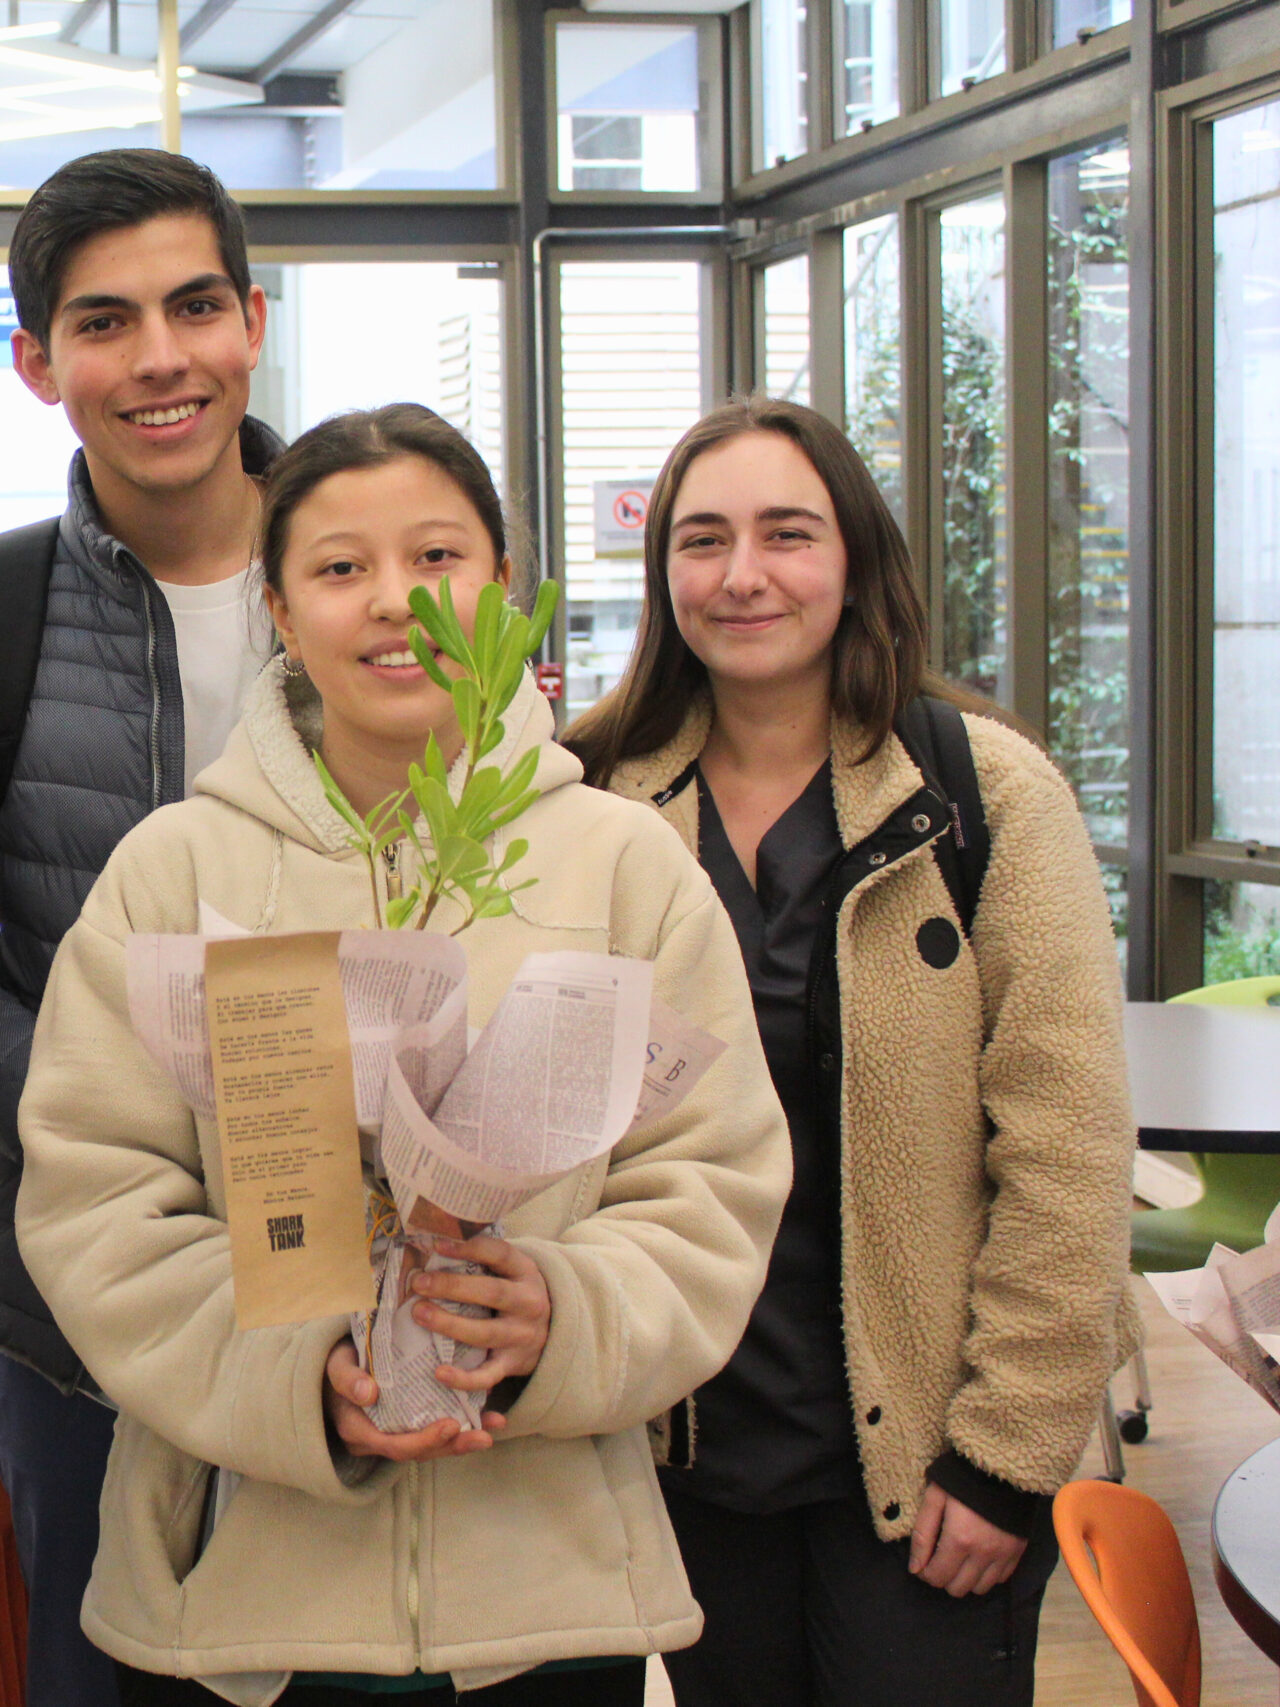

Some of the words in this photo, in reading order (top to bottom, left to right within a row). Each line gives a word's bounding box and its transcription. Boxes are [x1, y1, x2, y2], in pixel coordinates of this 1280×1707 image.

[664, 1058, 687, 1082] B
[266, 1214, 305, 1234] SHARK
[268, 1230, 306, 1252] TANK
